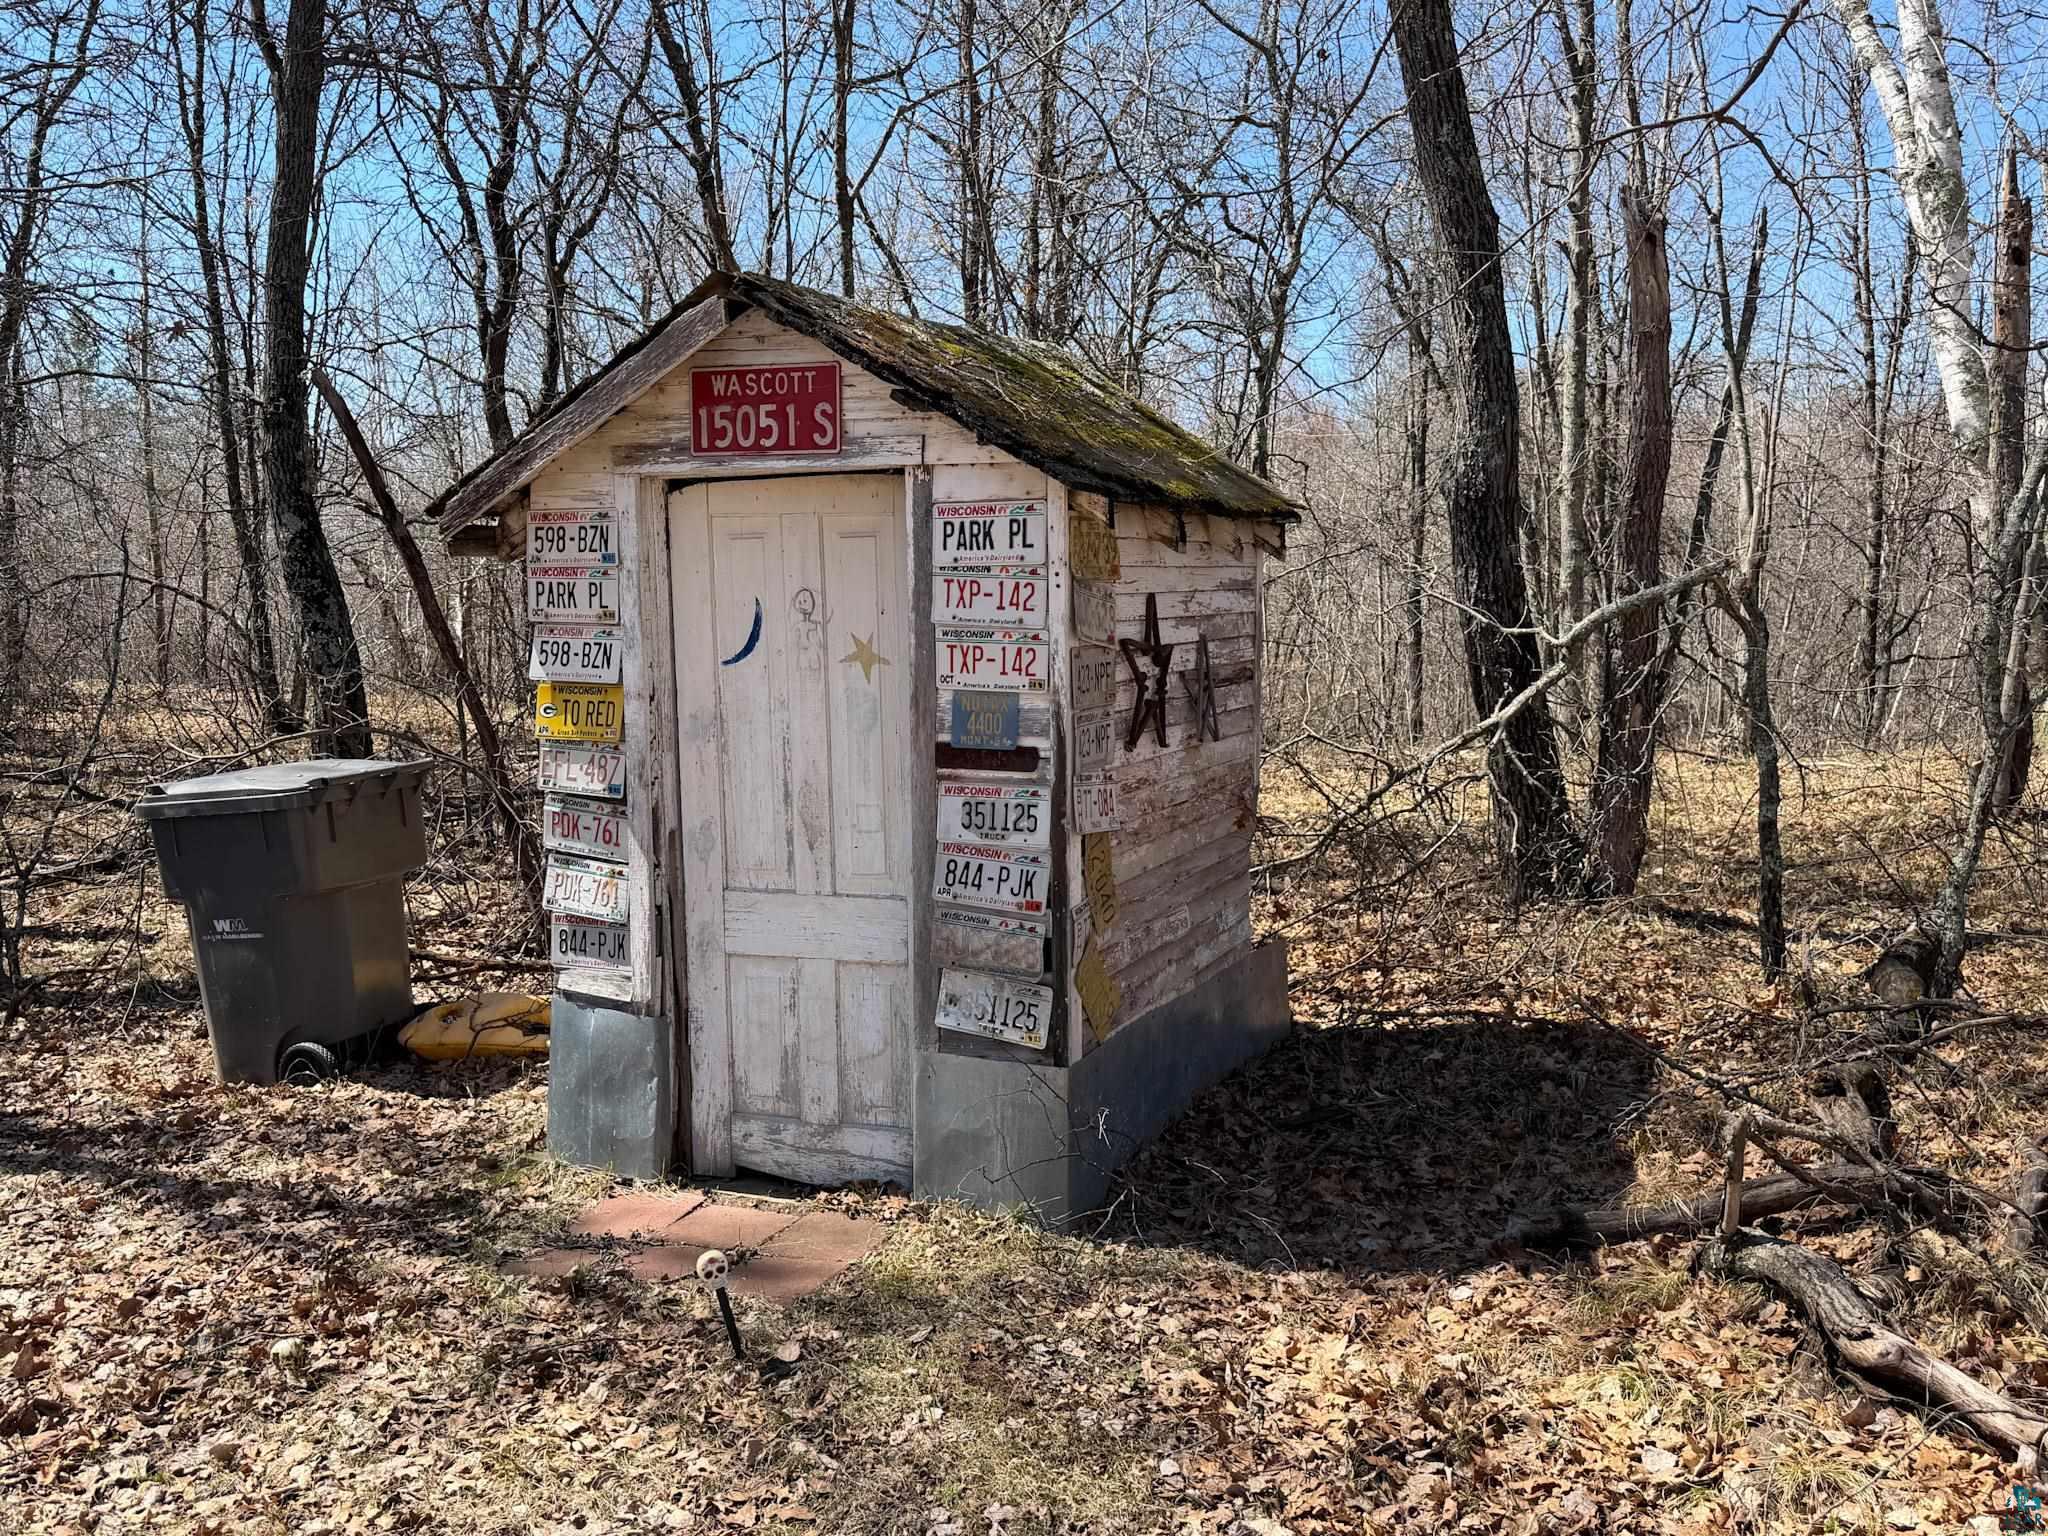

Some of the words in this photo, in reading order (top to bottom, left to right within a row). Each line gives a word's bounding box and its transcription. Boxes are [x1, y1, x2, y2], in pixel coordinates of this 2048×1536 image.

[712, 371, 816, 397] WASCOTT
[699, 403, 796, 449] 15051
[812, 401, 834, 447] S
[529, 511, 578, 522] WISCONSIN
[936, 505, 997, 517] WISCONSIN
[534, 525, 609, 554] 598-BZN
[942, 519, 995, 551] PARK
[1009, 518, 1034, 549] PL
[530, 567, 578, 577] WISCONSIN
[939, 566, 992, 574] WISCONSIN
[535, 581, 577, 609] PARK
[588, 582, 609, 609] PL
[943, 578, 1035, 612] TXP-142
[537, 626, 584, 637] WISCONSIN
[942, 629, 995, 639] WISCONSIN
[539, 641, 613, 670] 598-BZN
[946, 644, 1037, 677] TXP-142
[939, 674, 954, 685] OCT
[558, 686, 603, 696] WISCONSIN
[562, 699, 579, 727] TO
[585, 700, 616, 728] RED
[943, 785, 1003, 797] WISCONSIN
[550, 797, 591, 809] WISCONSIN
[961, 800, 1039, 833] 351125
[551, 811, 621, 848] PDK-761
[978, 832, 1007, 841] TRUCK
[942, 842, 1002, 860] WISCONSIN
[553, 857, 591, 870] WISCONSIN
[945, 859, 1038, 900] 844-PJK
[553, 871, 619, 910] PDK-761
[937, 887, 951, 897] APR
[213, 919, 248, 932] WM
[940, 910, 991, 926] WISCONSIN
[559, 929, 626, 961] 844-PJK
